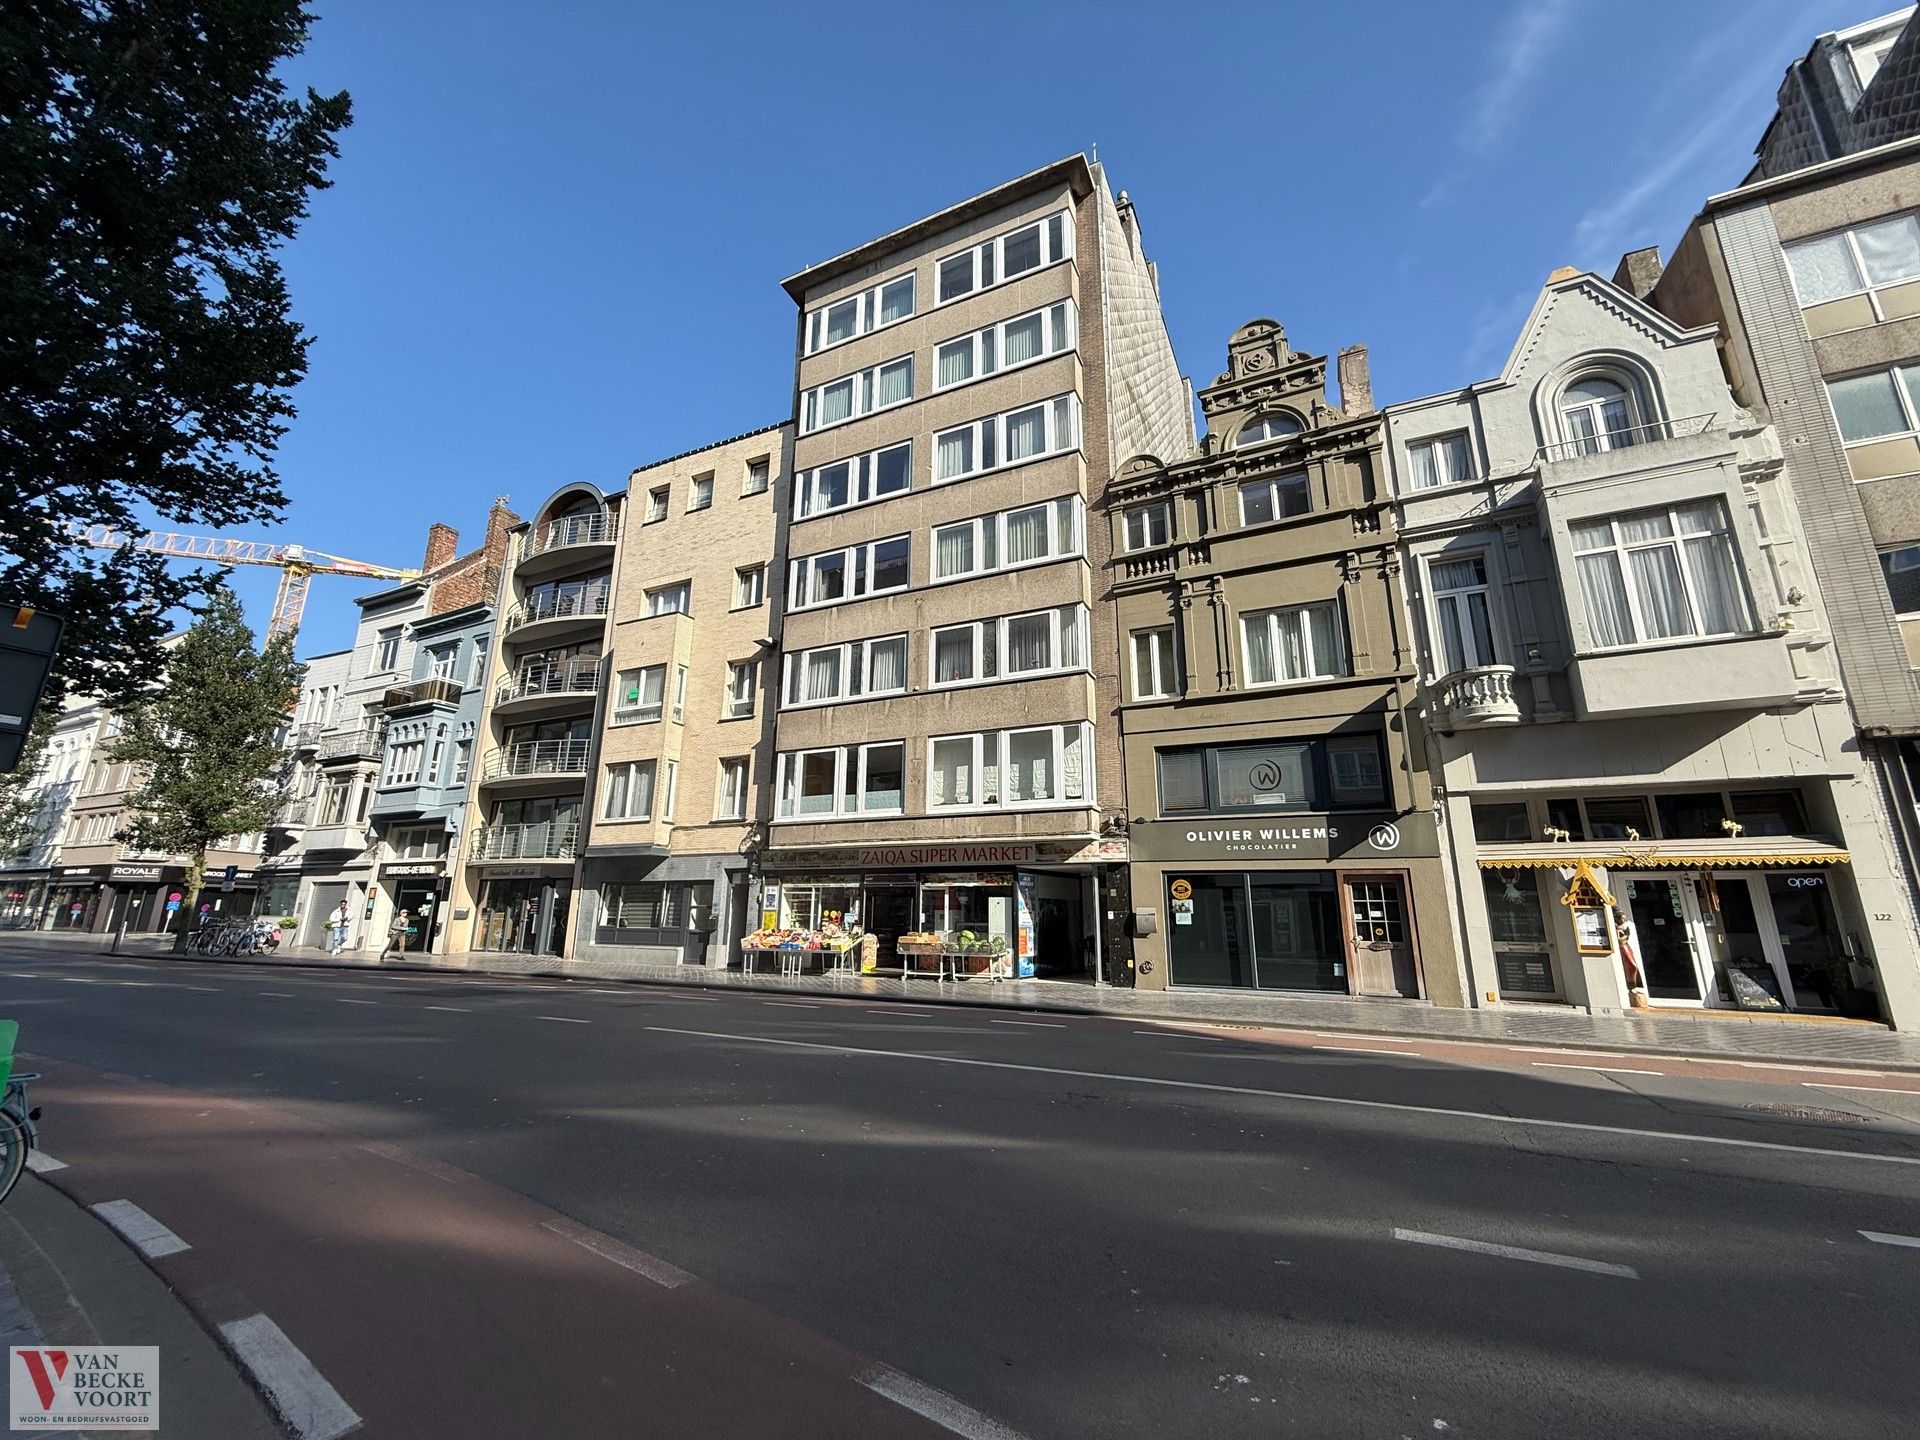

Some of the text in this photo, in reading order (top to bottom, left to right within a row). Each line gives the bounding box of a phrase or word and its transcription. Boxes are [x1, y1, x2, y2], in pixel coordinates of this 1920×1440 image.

[1186, 827, 1339, 842] OLIVIER WILLEMS
[861, 850, 906, 866] ZAIQA
[910, 849, 957, 863] SUPER
[962, 846, 1033, 862] MARKET
[113, 867, 161, 875] ROYALE
[1787, 877, 1823, 888] open
[1874, 913, 1892, 921] 122
